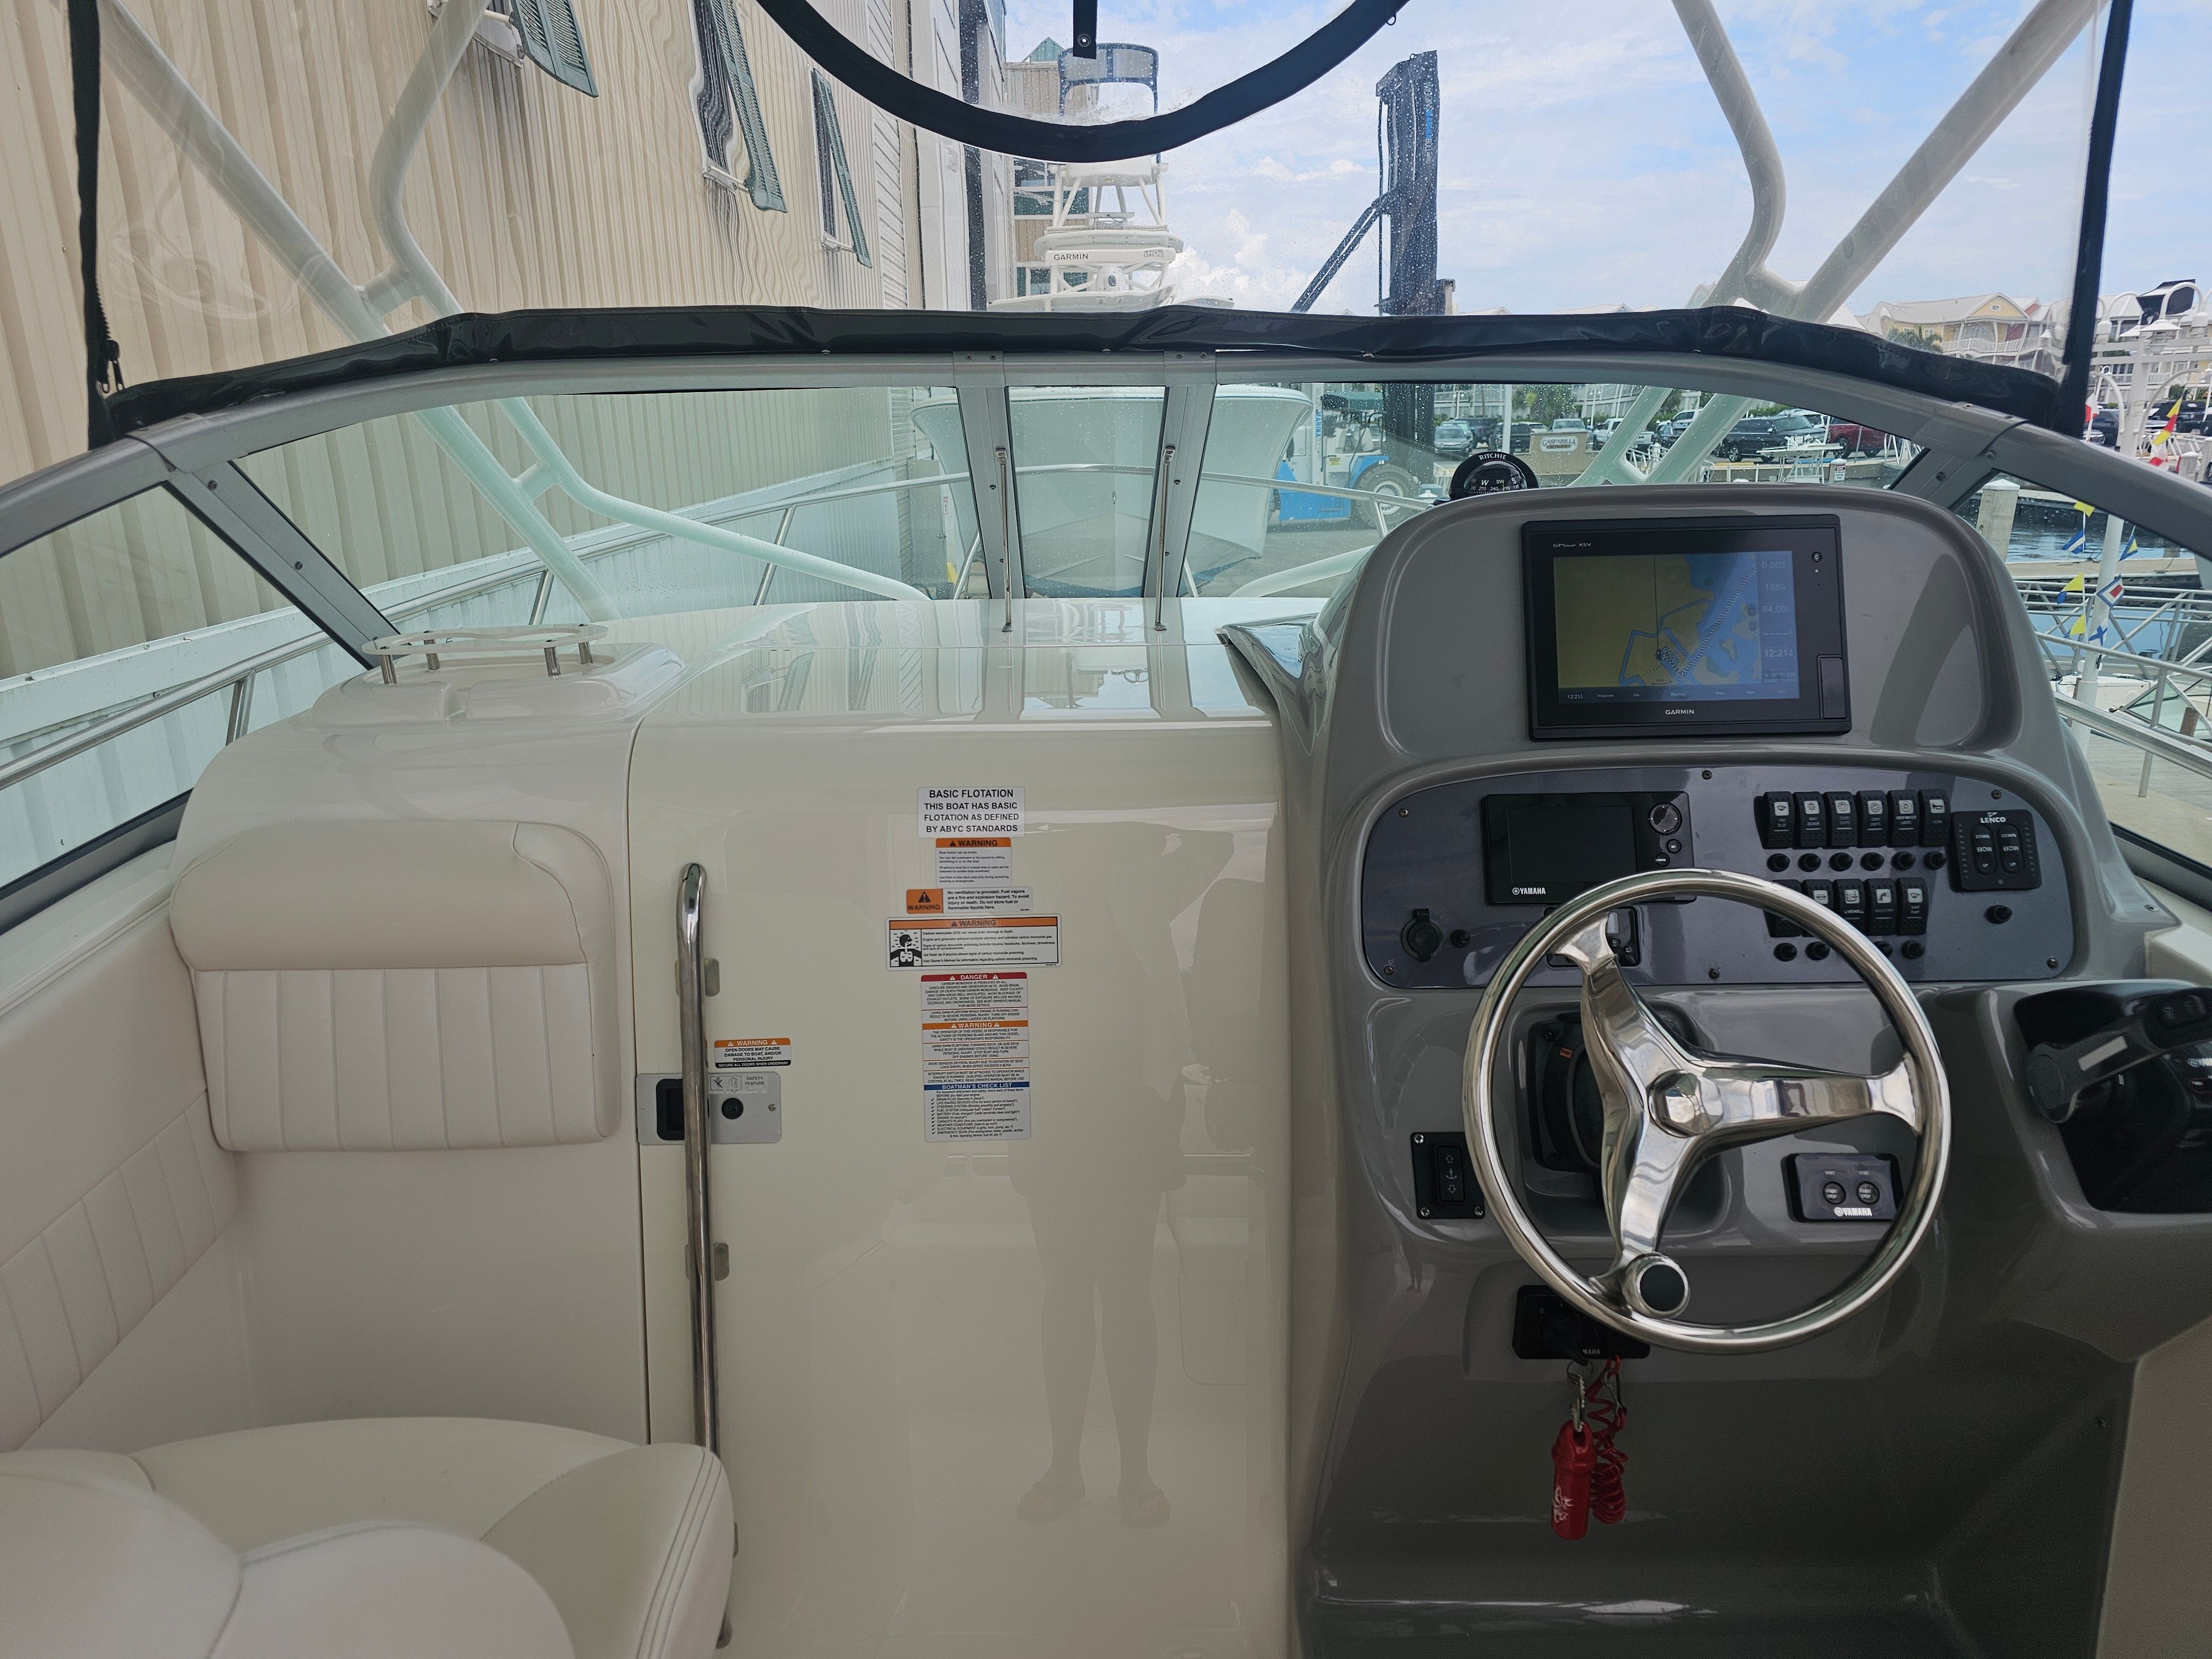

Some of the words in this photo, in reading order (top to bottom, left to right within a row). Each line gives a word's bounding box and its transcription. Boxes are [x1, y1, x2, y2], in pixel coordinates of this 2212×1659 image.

[1479, 452, 1507, 461] RITCHIE
[929, 790, 958, 798] BASIC
[961, 789, 1013, 798] FLOTATION
[1841, 1208, 1872, 1217] YAMAHA
